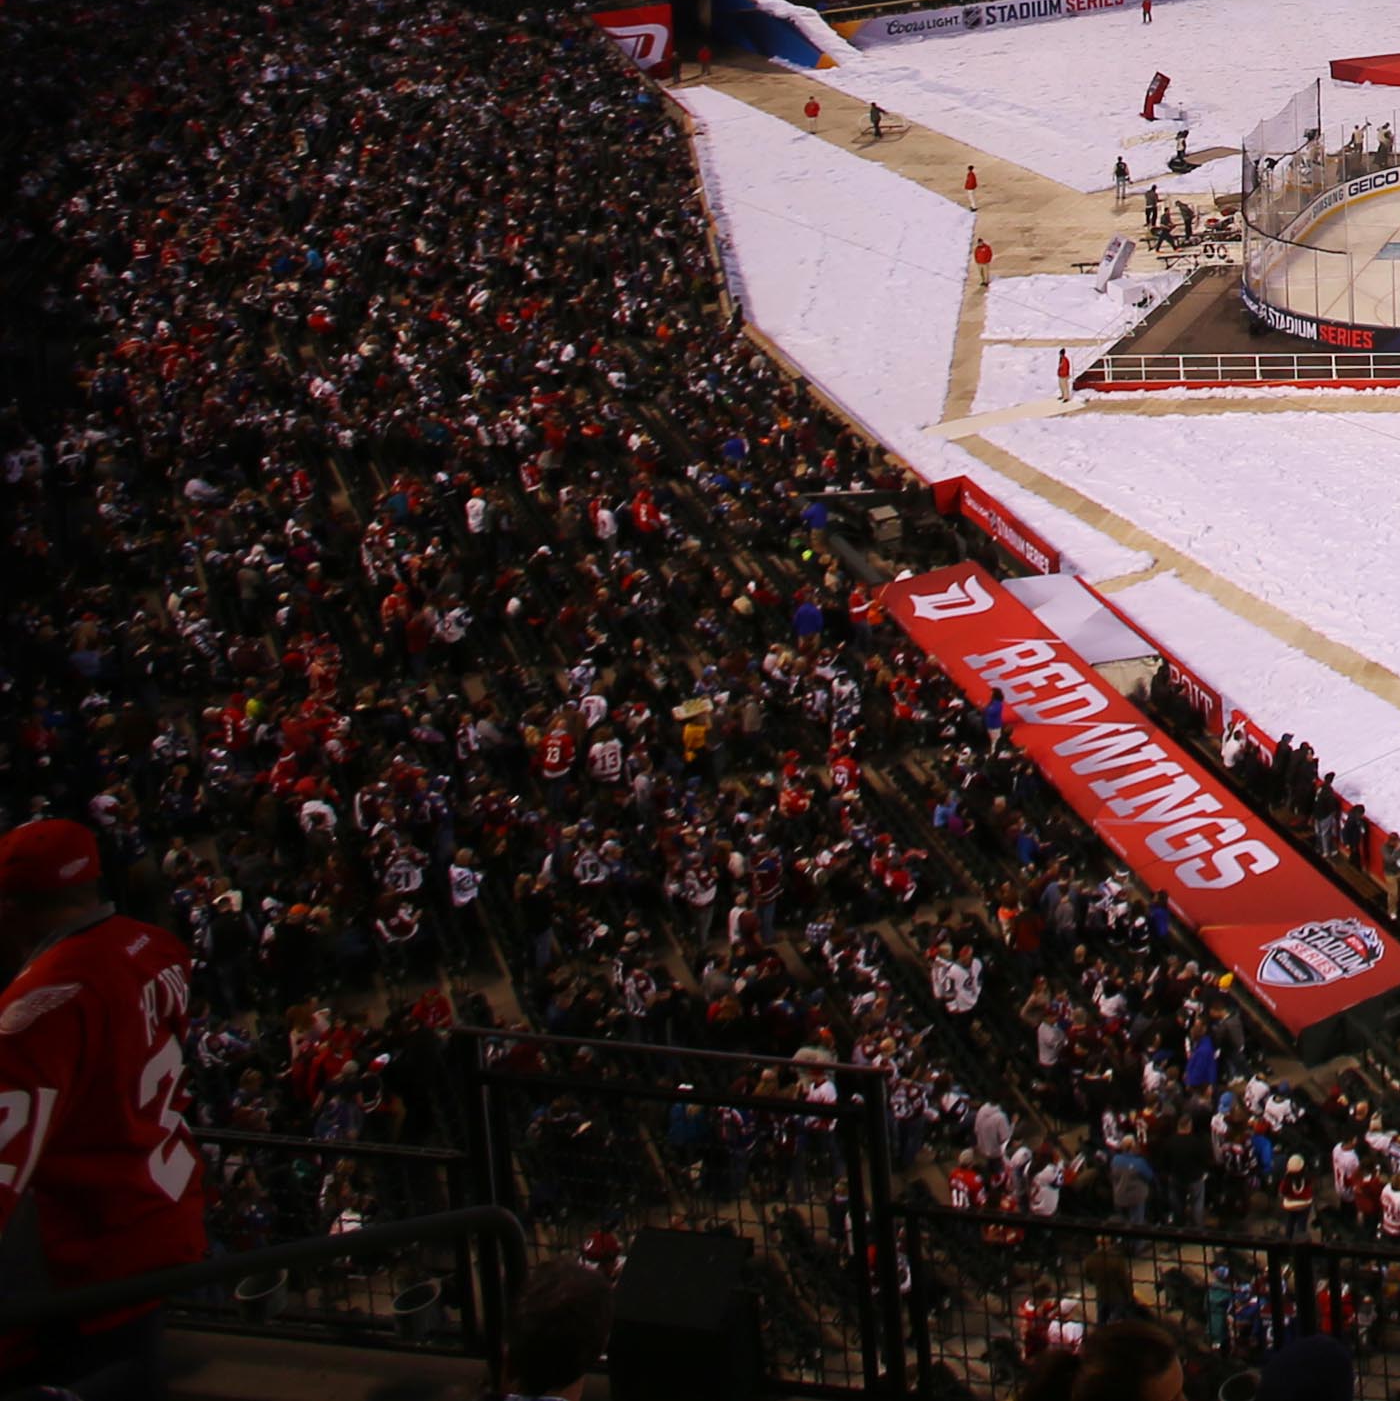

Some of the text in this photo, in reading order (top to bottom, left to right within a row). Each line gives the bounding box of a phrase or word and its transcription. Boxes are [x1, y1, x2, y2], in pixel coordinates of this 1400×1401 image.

[887, 18, 927, 37] Coors
[927, 14, 960, 31] LIGHT
[1348, 169, 1400, 197] GEICO
[1311, 187, 1344, 218] SAMSUNG
[1267, 308, 1373, 349] STADIUM SERIES
[1024, 544, 1050, 574] SERIES
[600, 751, 618, 771] 13
[963, 636, 1281, 890] RED WINGS
[1289, 941, 1338, 976] SERIES
[1294, 925, 1370, 976] STADIUM
